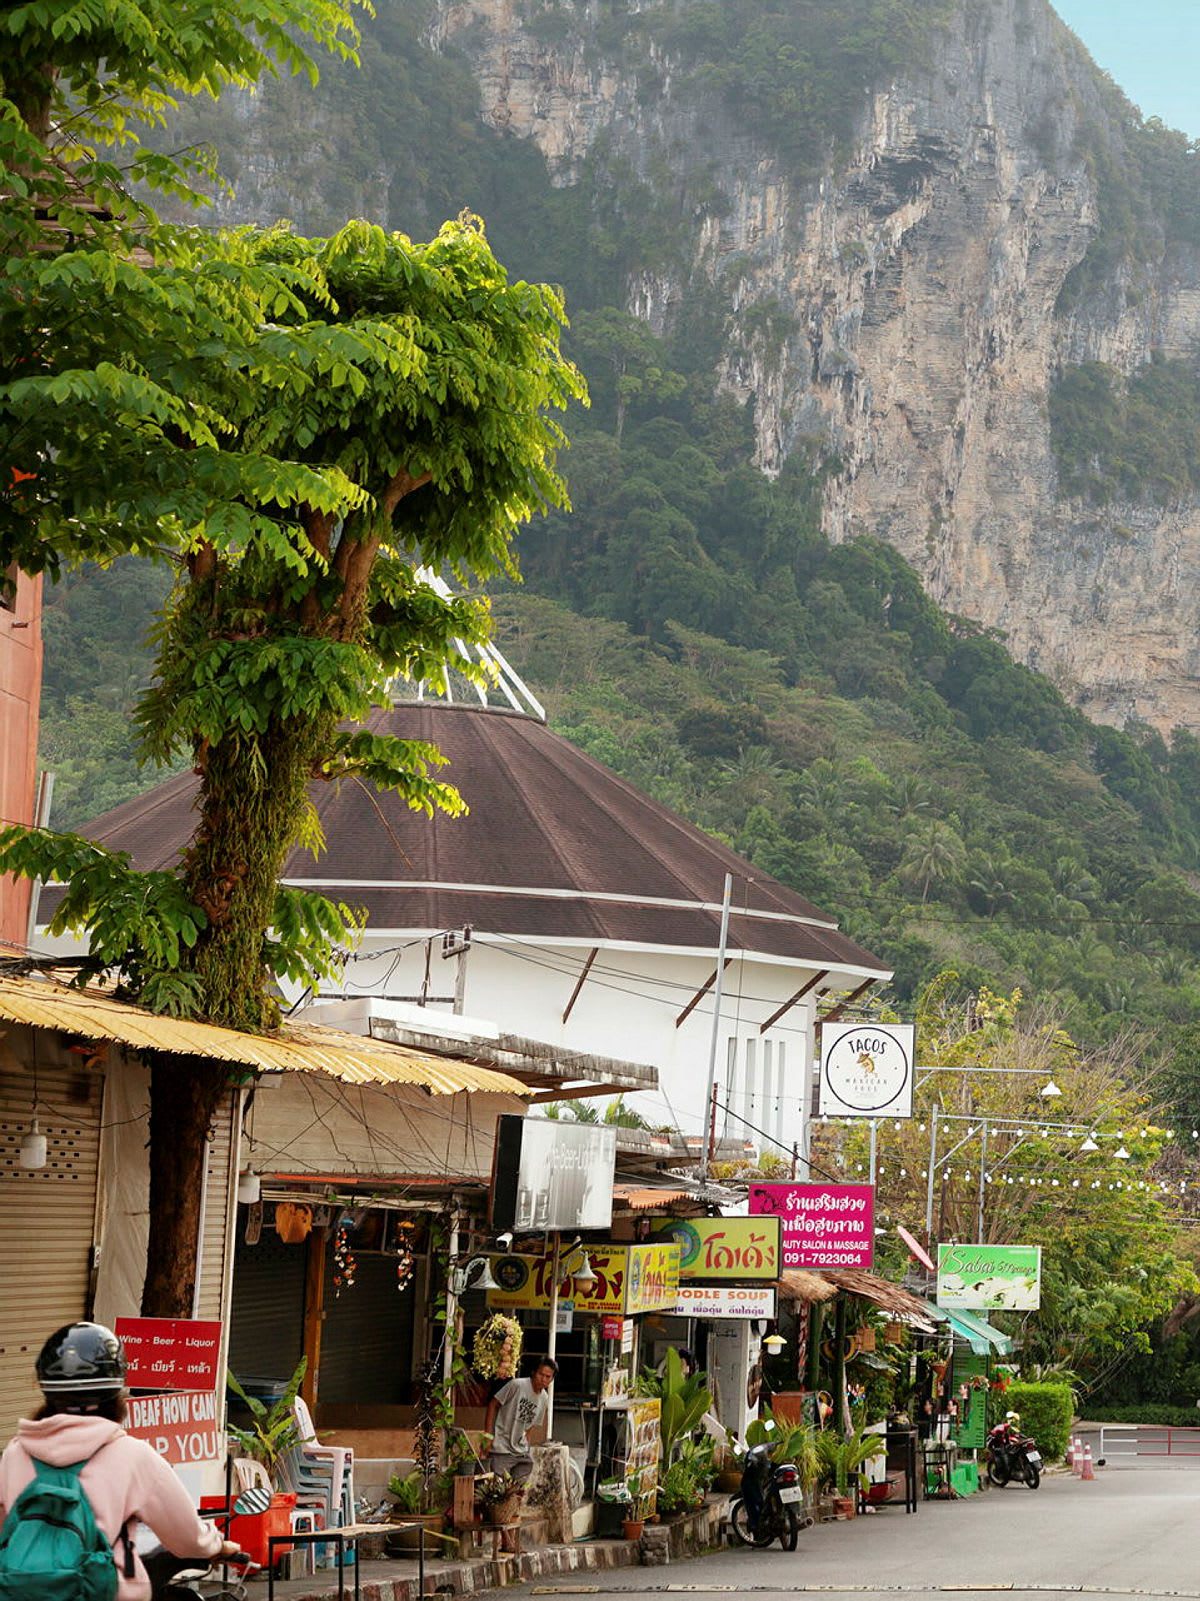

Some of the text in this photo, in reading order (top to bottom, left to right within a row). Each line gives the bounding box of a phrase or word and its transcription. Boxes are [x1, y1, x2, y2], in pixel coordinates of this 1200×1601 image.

[848, 1038, 887, 1055] TACOS
[786, 1191, 866, 1211] ร้านเสริมสวย
[783, 1241, 800, 1249] AUTY
[802, 1241, 826, 1249] SALON
[834, 1241, 869, 1250] MASSAGE
[784, 1253, 861, 1264] 091-7923064
[728, 1291, 768, 1300] SOUP
[120, 1335, 215, 1347] Wine Beer Liquor
[126, 1358, 211, 1373] วน์ เบียร์ เหล้า
[132, 1399, 159, 1427] DEAF
[162, 1396, 189, 1425] HOW
[192, 1393, 215, 1421] CAN
[175, 1431, 216, 1461] YOU
